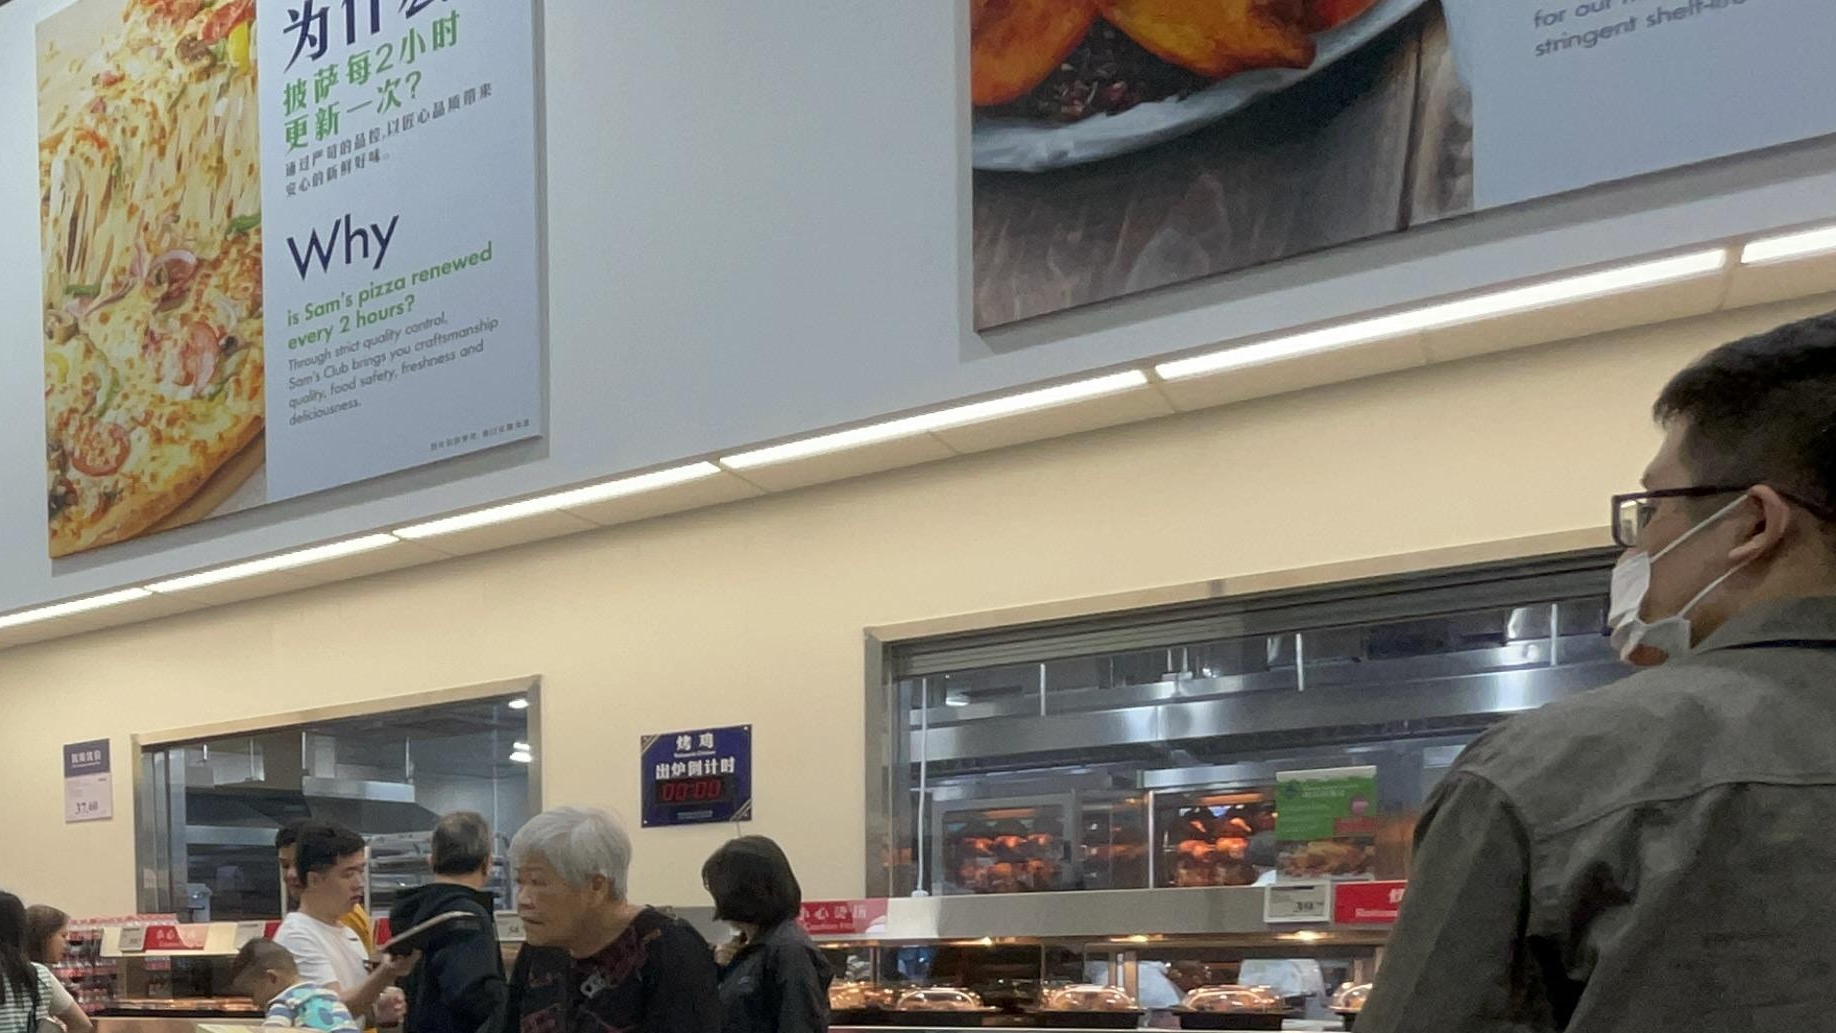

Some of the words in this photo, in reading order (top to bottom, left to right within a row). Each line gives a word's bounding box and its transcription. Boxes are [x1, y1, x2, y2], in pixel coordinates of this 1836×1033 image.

[1534, 9, 1567, 29] for
[1574, 0, 1613, 18] our
[1535, 17, 1637, 56] stringent
[283, 9, 460, 117] 披萨每2小时
[283, 71, 422, 155] 更新一次？
[286, 213, 400, 281] Why
[287, 309, 299, 327] is
[304, 292, 353, 321] Sam's
[358, 276, 406, 307] pizza
[411, 241, 493, 286] renewed
[288, 323, 334, 350] every
[340, 315, 351, 333] 2
[356, 294, 416, 328] hours?
[288, 346, 331, 371] Through
[334, 341, 360, 358] strict
[362, 327, 403, 349] quality
[404, 311, 449, 335] control,
[288, 373, 321, 390] Sam's
[323, 360, 349, 379] Club
[351, 351, 386, 370] brings
[389, 344, 411, 362] you
[413, 316, 499, 352] craftsmanship
[288, 390, 327, 409] quality,
[330, 379, 357, 396] food
[359, 368, 398, 387] safety,
[400, 350, 456, 374] freshness
[459, 338, 484, 357] and
[288, 398, 362, 427] deliciousness.
[655, 756, 736, 780] 出炉倒计时
